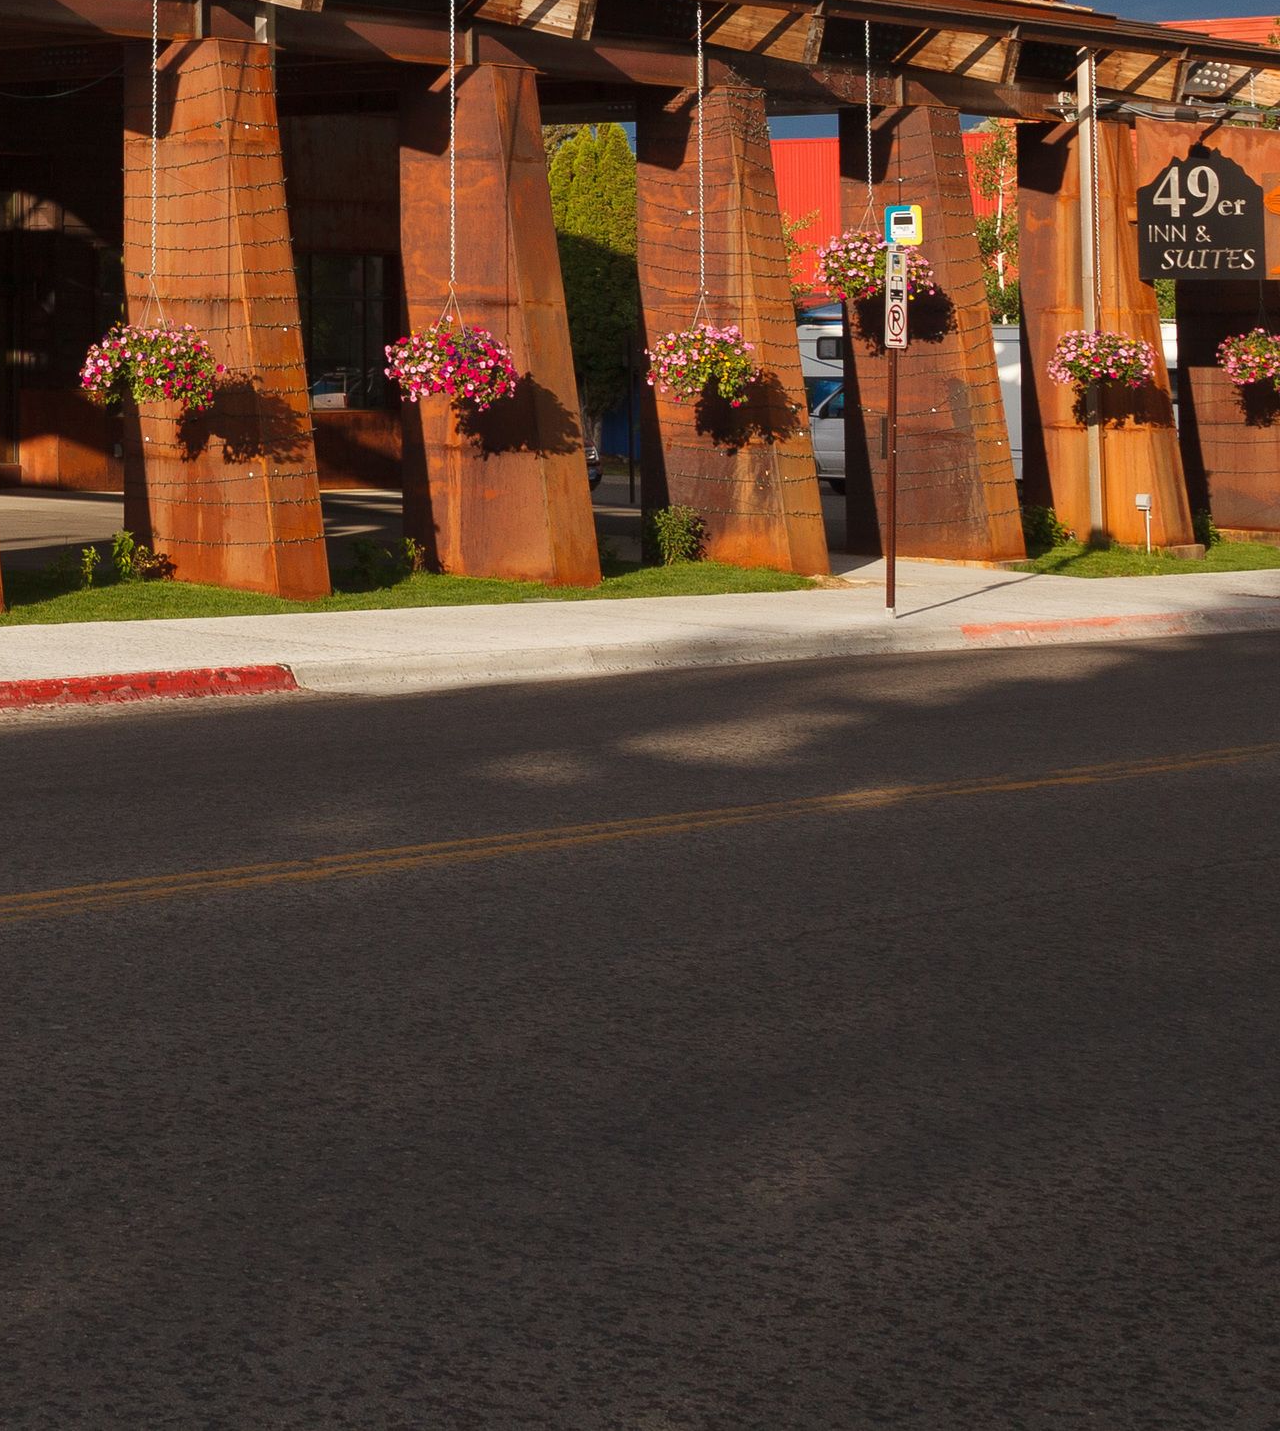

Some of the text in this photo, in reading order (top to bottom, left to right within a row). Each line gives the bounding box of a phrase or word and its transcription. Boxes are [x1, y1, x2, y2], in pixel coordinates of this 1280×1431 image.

[1152, 166, 1246, 218] 49er
[1148, 224, 1212, 243] INN &
[1160, 248, 1256, 270] SUITES
